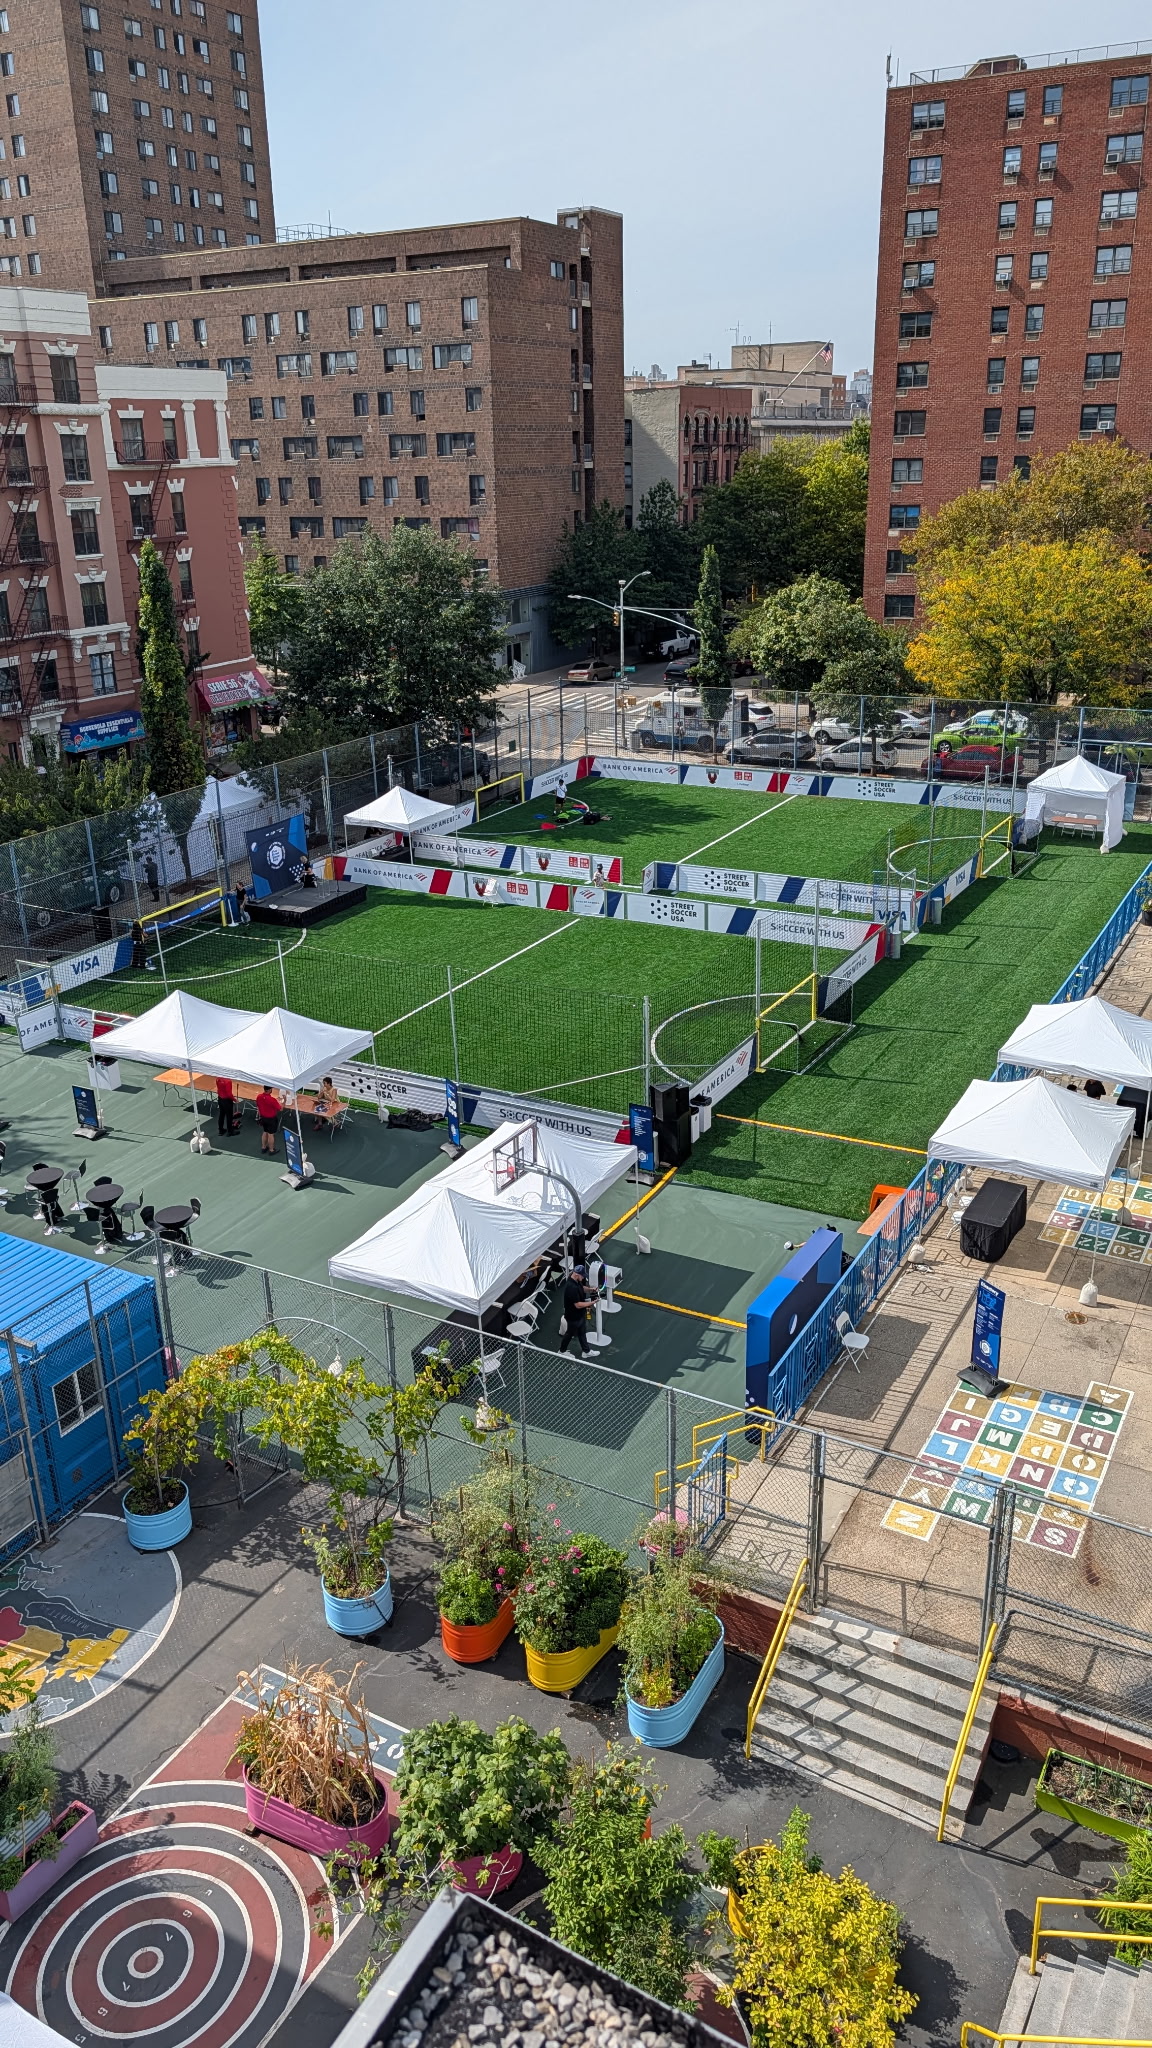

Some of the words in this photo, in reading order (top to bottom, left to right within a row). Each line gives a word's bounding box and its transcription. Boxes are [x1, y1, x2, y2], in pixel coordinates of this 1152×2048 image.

[207, 680, 230, 693] SERIE
[226, 679, 238, 690] 56
[632, 766, 663, 775] AMERICA
[413, 841, 434, 849] BANK
[446, 845, 482, 856] AMERICA
[353, 866, 371, 874] BANK
[382, 871, 413, 880] AMERICA
[724, 873, 748, 881] STREET
[724, 880, 750, 888] SOCCER
[670, 902, 694, 911] STREET
[670, 909, 697, 918] SOCCER
[670, 915, 685, 923] USA
[770, 923, 806, 934] SOCCER
[807, 927, 831, 938] WTH
[832, 931, 845, 940] US
[70, 955, 100, 976] VISA
[20, 1027, 31, 1037] OF
[374, 1081, 408, 1094] SOCCER
[706, 1065, 735, 1095] AMERICA
[375, 1089, 393, 1100] USA
[499, 1108, 542, 1125] SOCCER
[541, 1116, 576, 1133] WITH
[576, 1125, 592, 1137] US
[1067, 1189, 1093, 1201] 10
[1061, 1202, 1090, 1215] 11
[1052, 1215, 1084, 1228] 23
[1087, 1222, 1119, 1236] 21
[1078, 1236, 1108, 1251] 22
[1121, 1231, 1150, 1244] 17
[1112, 1245, 1142, 1259] 20
[1099, 1388, 1122, 1406] A
[1048, 1396, 1070, 1415] B
[999, 1407, 1022, 1423] G
[1090, 1410, 1113, 1426] C
[950, 1418, 971, 1432] J
[1039, 1419, 1061, 1436] E
[985, 1428, 1014, 1447] M
[1080, 1431, 1105, 1448] D
[941, 1439, 960, 1456] L
[1031, 1444, 1054, 1459] P
[981, 1450, 1001, 1467] K
[1072, 1454, 1096, 1471] O
[1018, 1463, 1045, 1481] N
[1067, 1476, 1094, 1495] Q
[952, 1498, 981, 1519] W
[895, 1510, 923, 1529] Z
[1043, 1527, 1067, 1546] S
